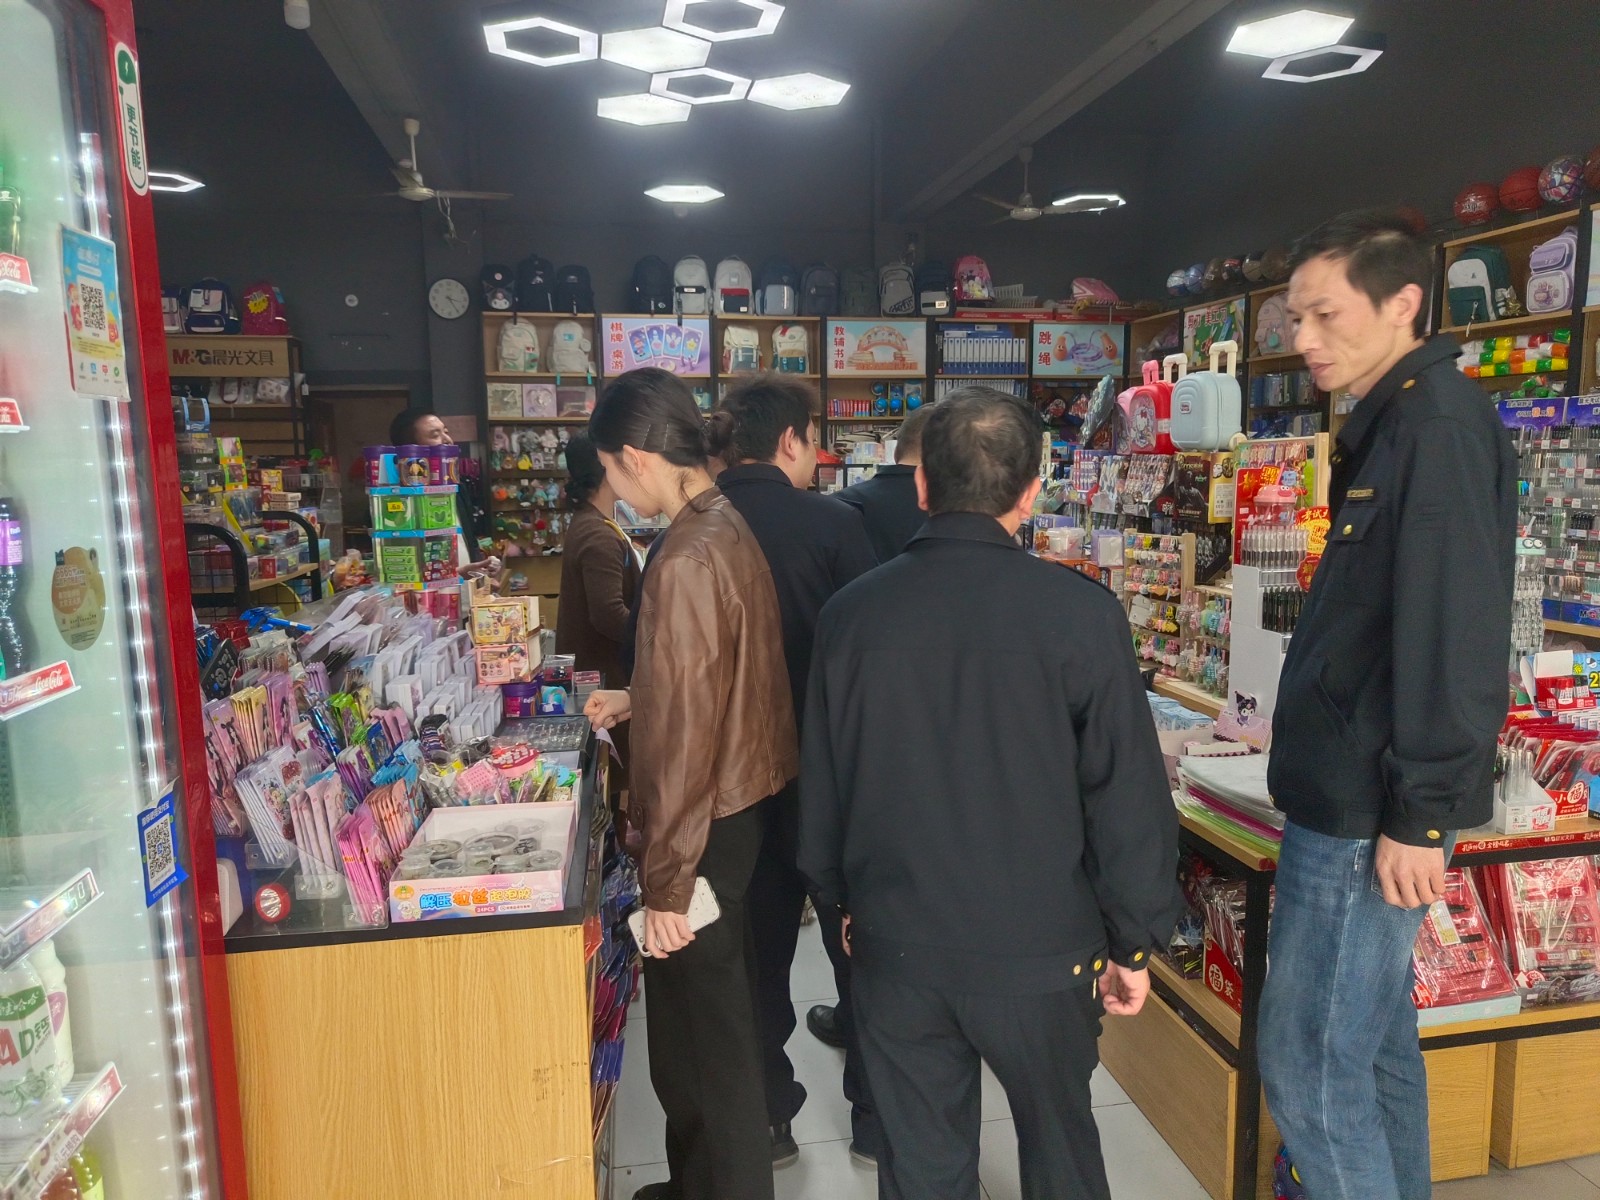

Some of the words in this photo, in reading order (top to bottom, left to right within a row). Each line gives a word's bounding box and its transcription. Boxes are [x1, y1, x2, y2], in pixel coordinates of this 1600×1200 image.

[126, 103, 141, 170] 更节能
[610, 322, 624, 343] 棋牌
[834, 326, 845, 370] 教辅书籍
[1038, 331, 1052, 366] 跳绳
[611, 349, 624, 370] 桌游
[1209, 964, 1234, 1000] 福袋
